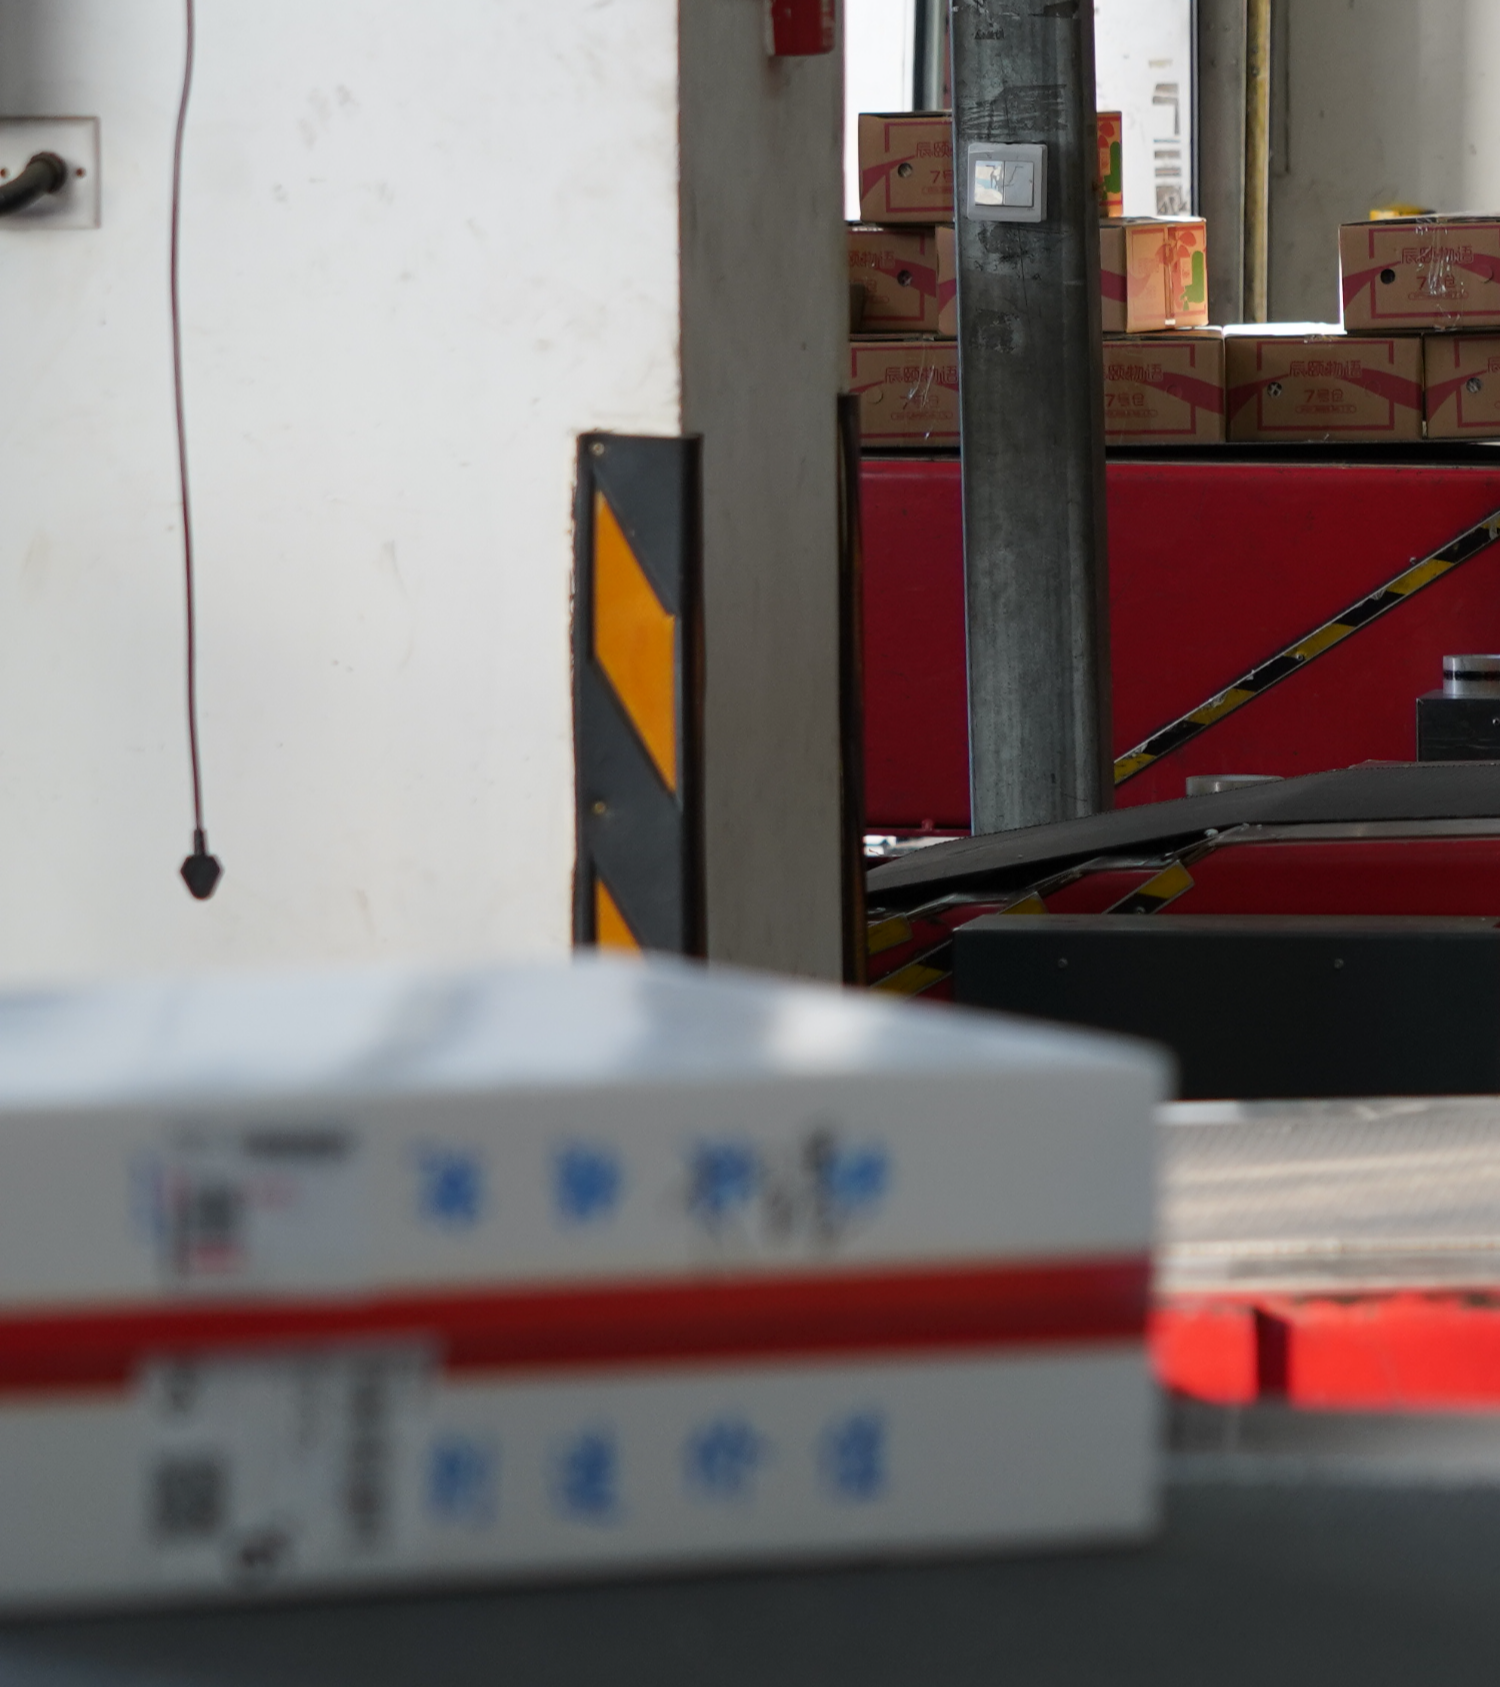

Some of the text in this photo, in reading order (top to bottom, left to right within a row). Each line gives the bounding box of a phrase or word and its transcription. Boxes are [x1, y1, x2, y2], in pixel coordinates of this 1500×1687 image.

[1400, 244, 1475, 264] 辰颐物语
[1289, 360, 1363, 378] 辰颐物语
[1304, 389, 1345, 403] 7号仓
